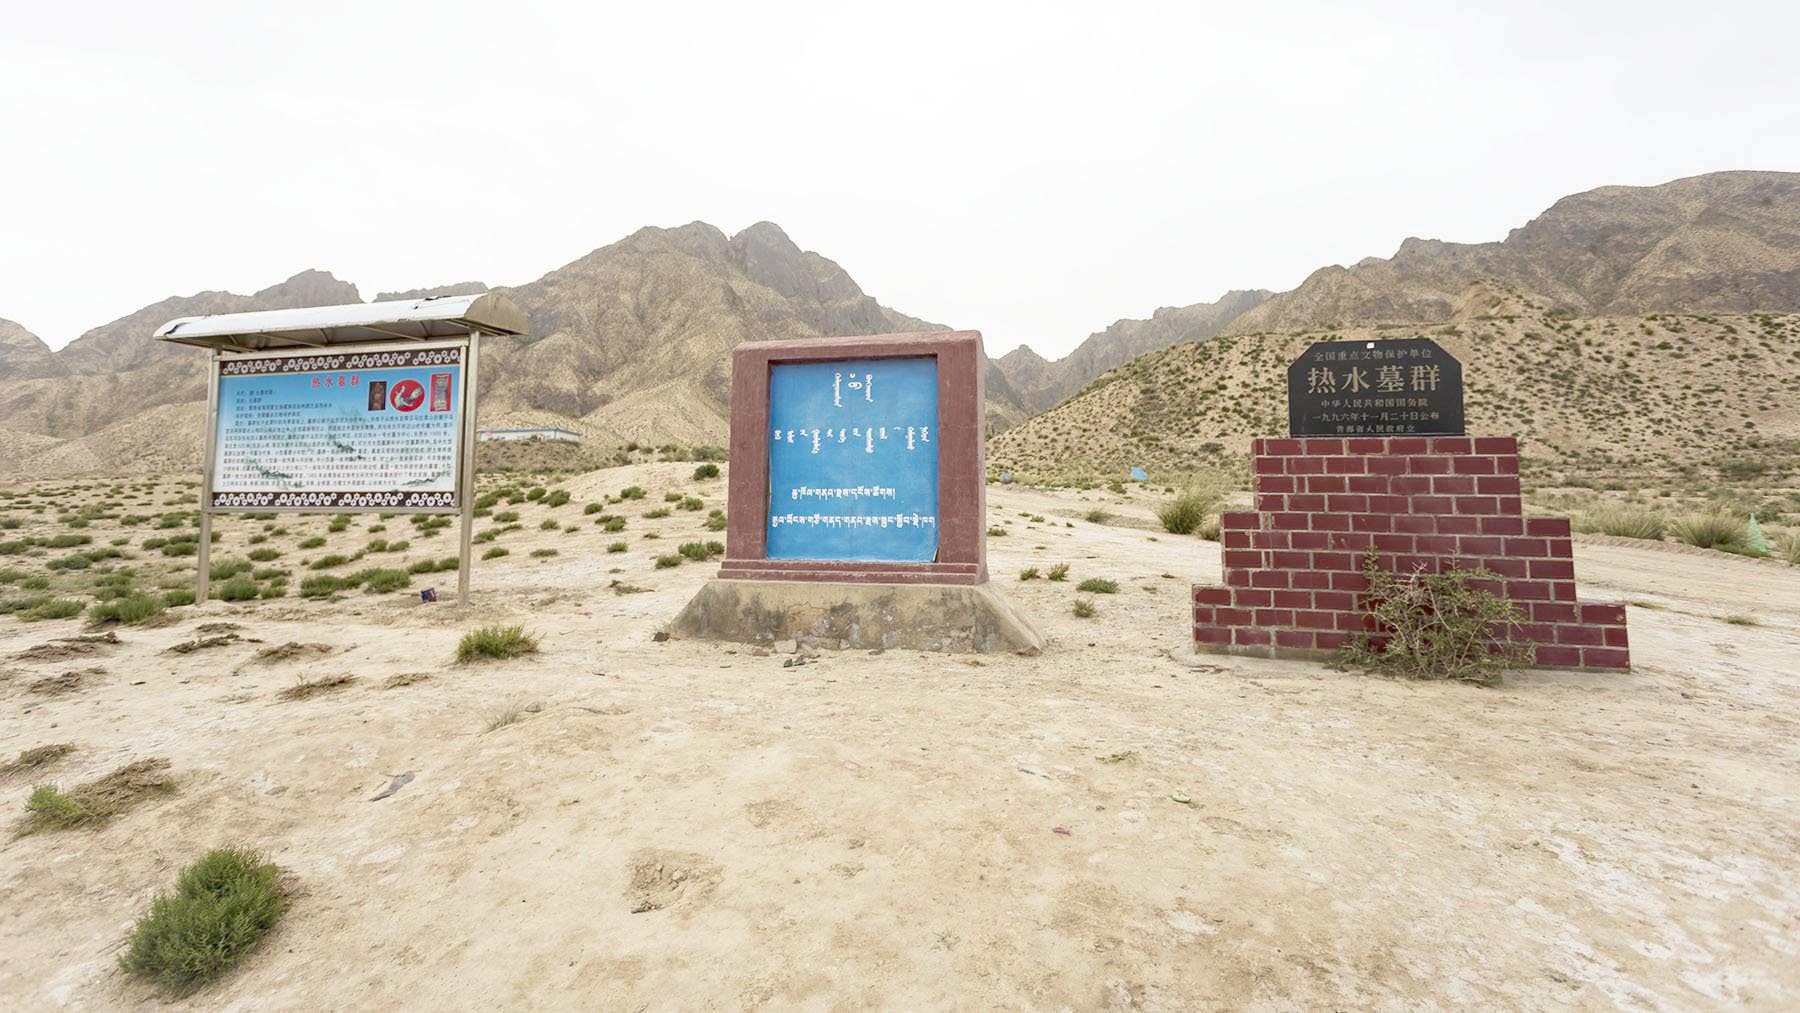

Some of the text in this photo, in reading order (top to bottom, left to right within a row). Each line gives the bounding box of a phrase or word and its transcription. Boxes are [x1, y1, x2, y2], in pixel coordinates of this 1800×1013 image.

[1314, 348, 1433, 362] 全国重点文物保护单位
[1307, 364, 1441, 395] 热水墓群
[1321, 398, 1429, 408] 中华人民共和国国务院
[1312, 411, 1440, 422] 一九九六年十一月二十日公布
